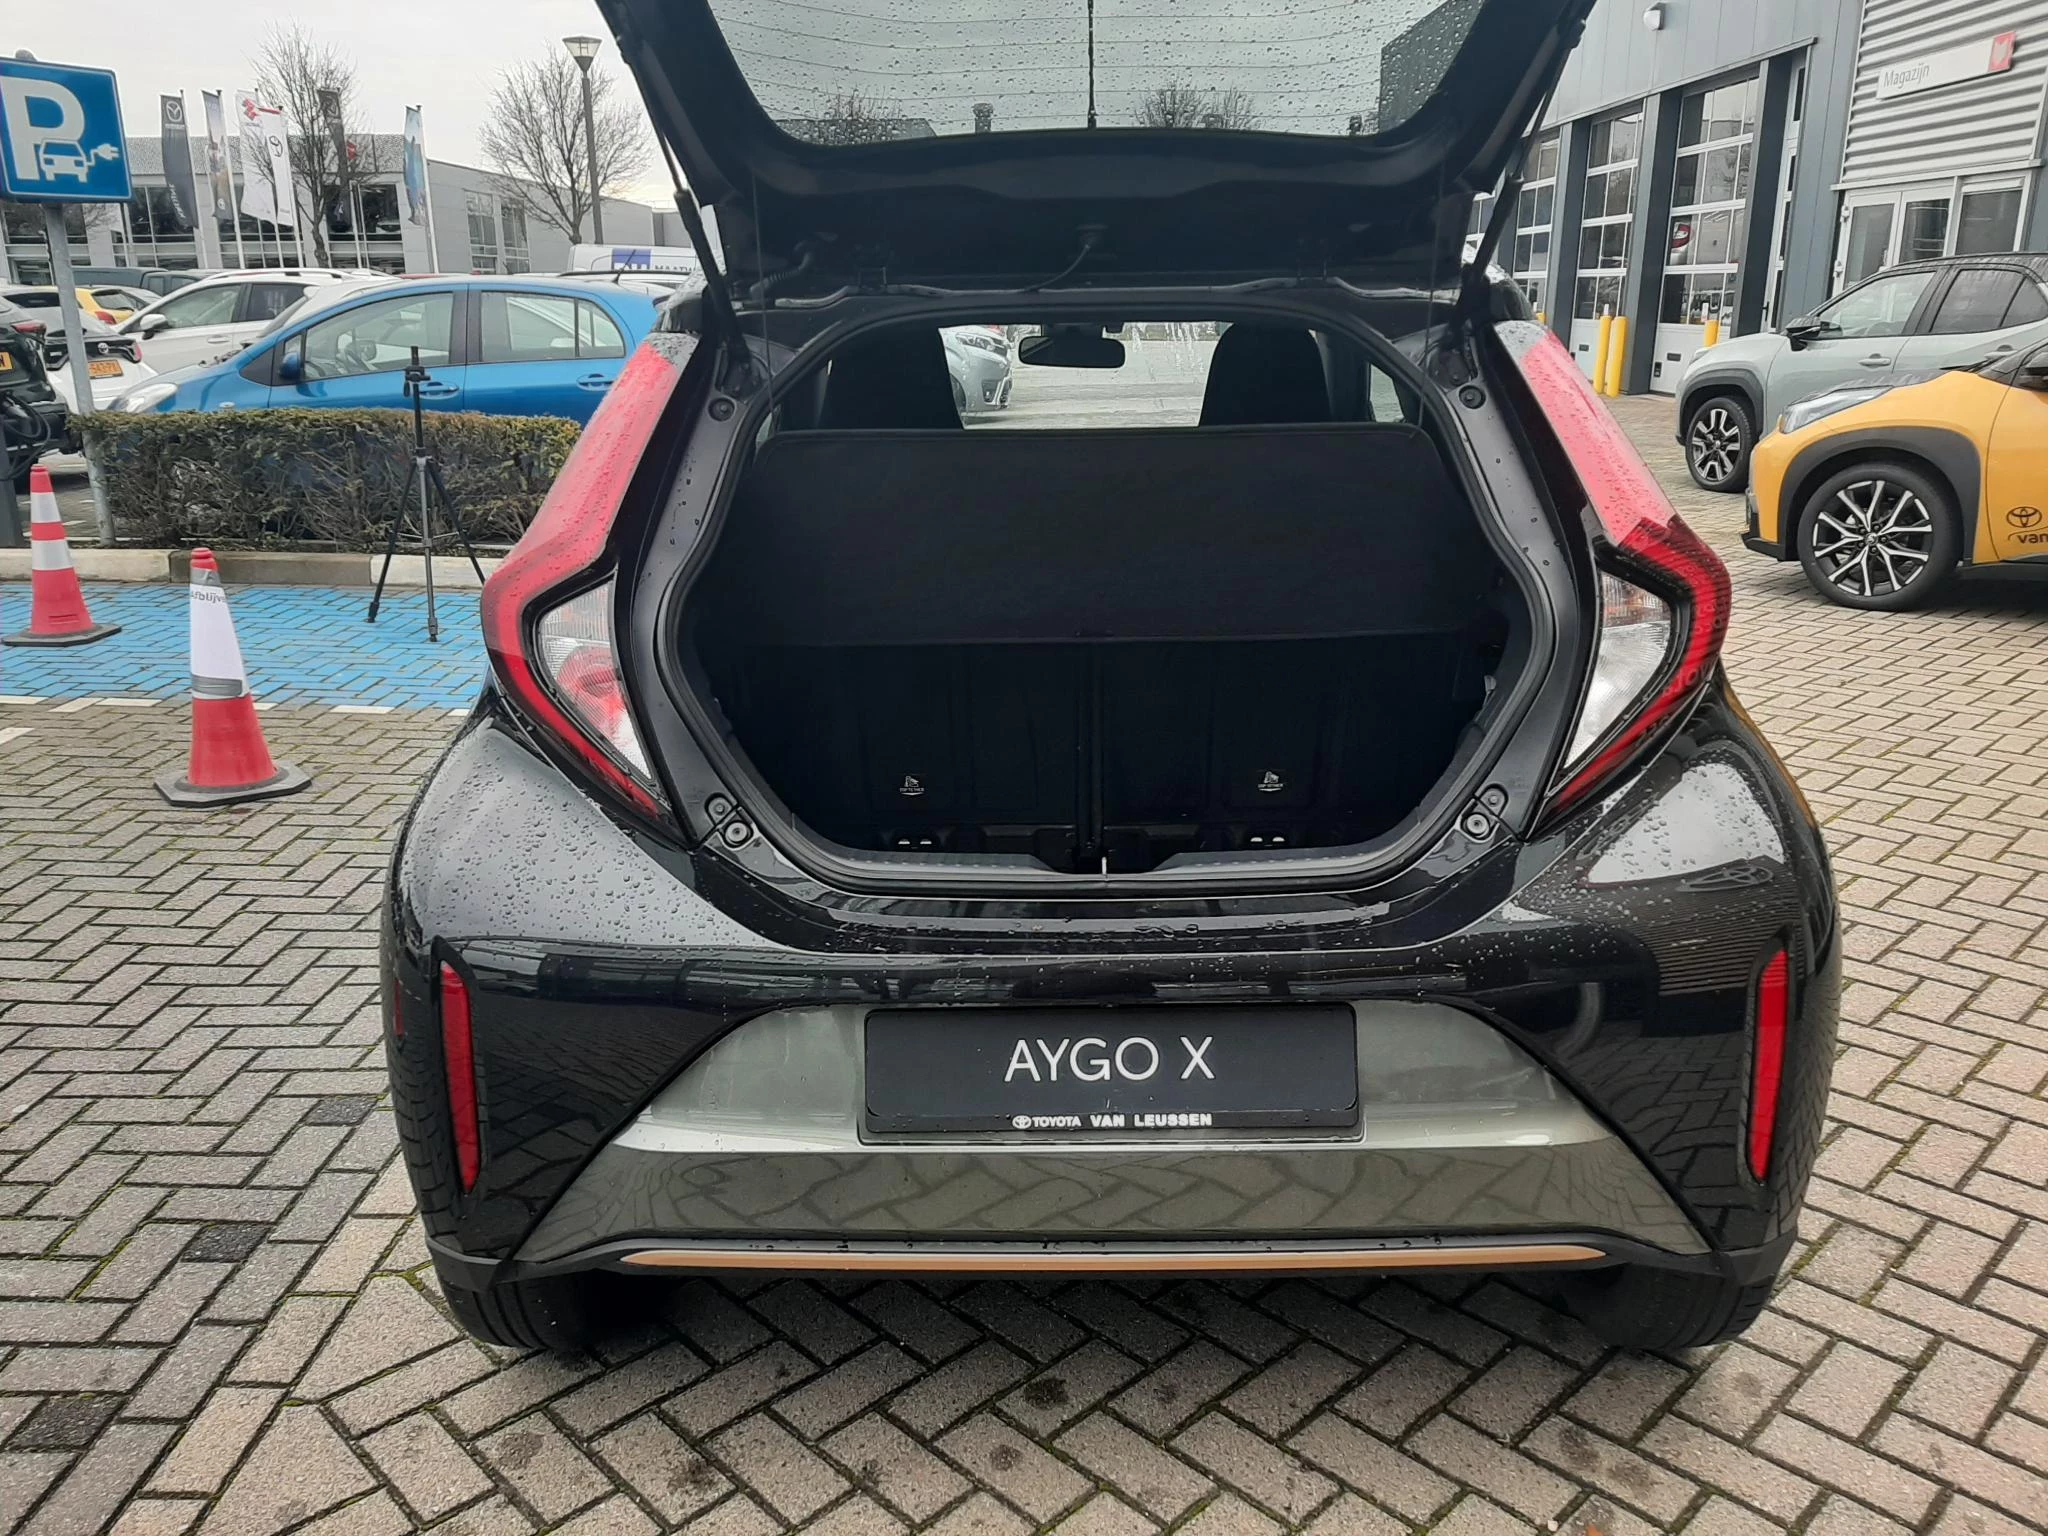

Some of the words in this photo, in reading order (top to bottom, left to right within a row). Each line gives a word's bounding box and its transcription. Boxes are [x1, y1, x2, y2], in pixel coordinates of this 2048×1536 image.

[1883, 63, 1930, 89] Magazijn
[0, 75, 85, 180] P
[2017, 533, 2048, 544] van
[1004, 1037, 1159, 1081] AYGO
[1180, 1036, 1215, 1079] X
[1032, 1115, 1081, 1128] TOYOTA
[1090, 1114, 1125, 1127] VAN
[1134, 1113, 1212, 1127] LEUSSEN
